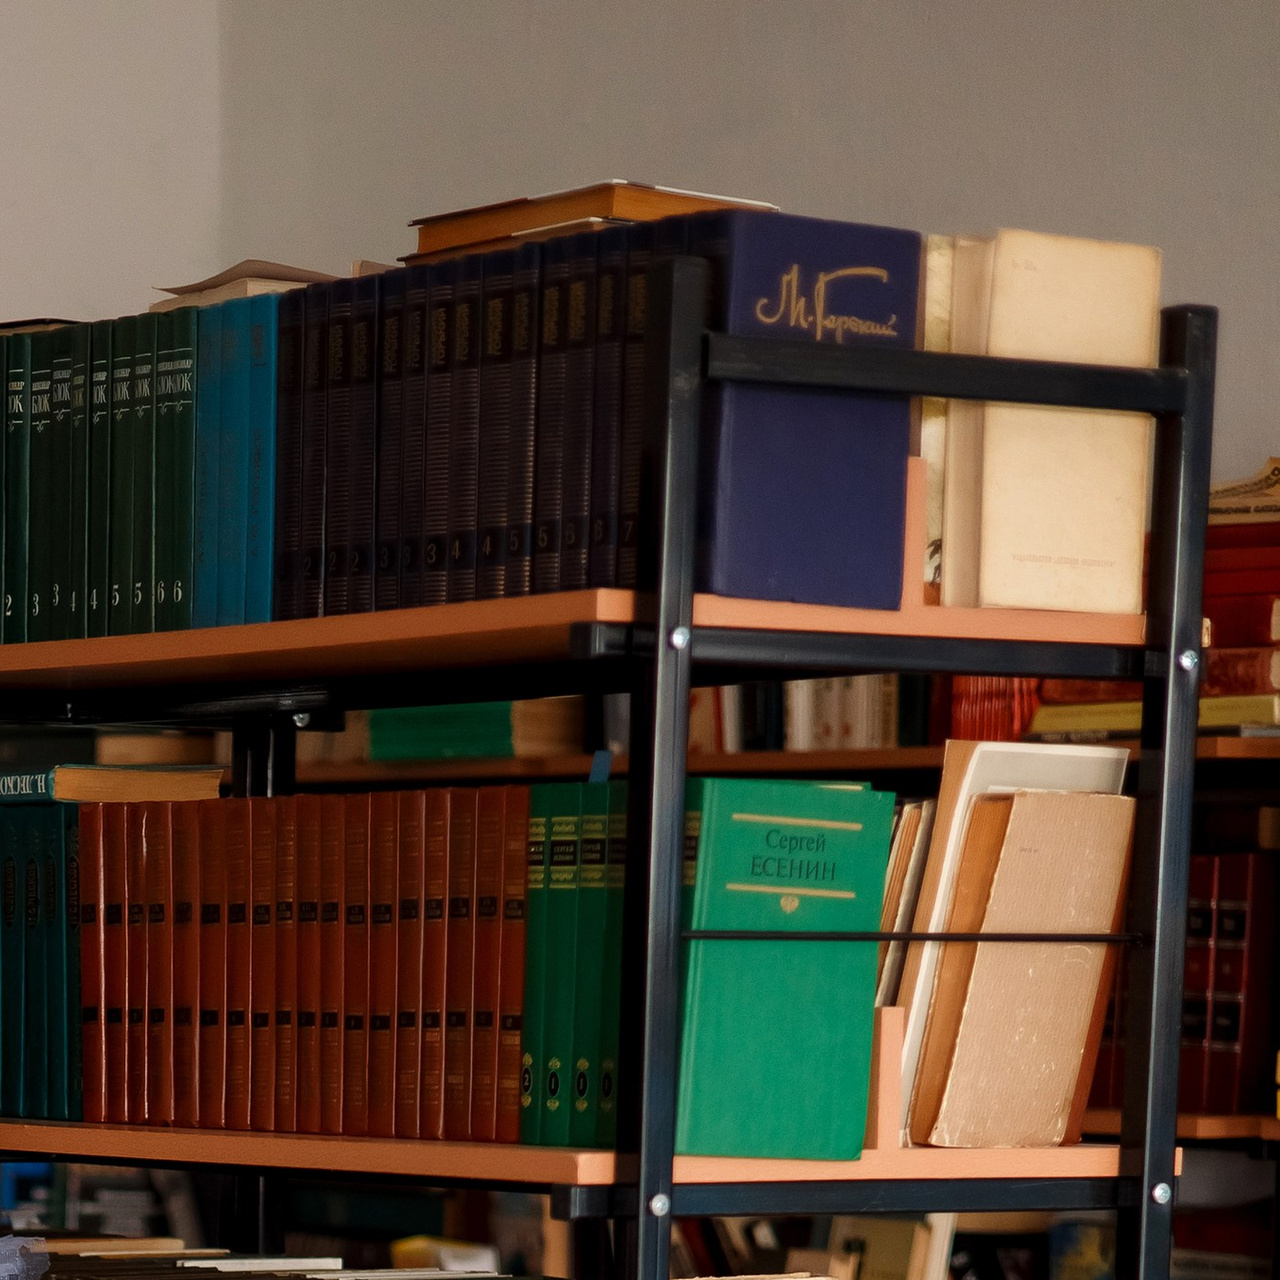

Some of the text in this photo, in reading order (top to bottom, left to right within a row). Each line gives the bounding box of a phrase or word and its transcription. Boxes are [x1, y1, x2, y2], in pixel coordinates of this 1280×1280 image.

[624, 521, 632, 541] 7
[427, 543, 436, 563] 3
[451, 540, 460, 560] 4
[482, 536, 492, 556] 4
[53, 583, 59, 606] 3
[70, 591, 76, 612] 4
[90, 589, 97, 609] 4
[112, 585, 119, 606] 5
[134, 582, 142, 605] 5
[158, 581, 165, 603] 6
[173, 580, 182, 602] 6
[6, 594, 12, 616] 2
[33, 593, 39, 616] 3
[35, 774, 47, 793] Н.
[765, 829, 827, 855] Сергей
[750, 855, 836, 881] ЕСЕНИН
